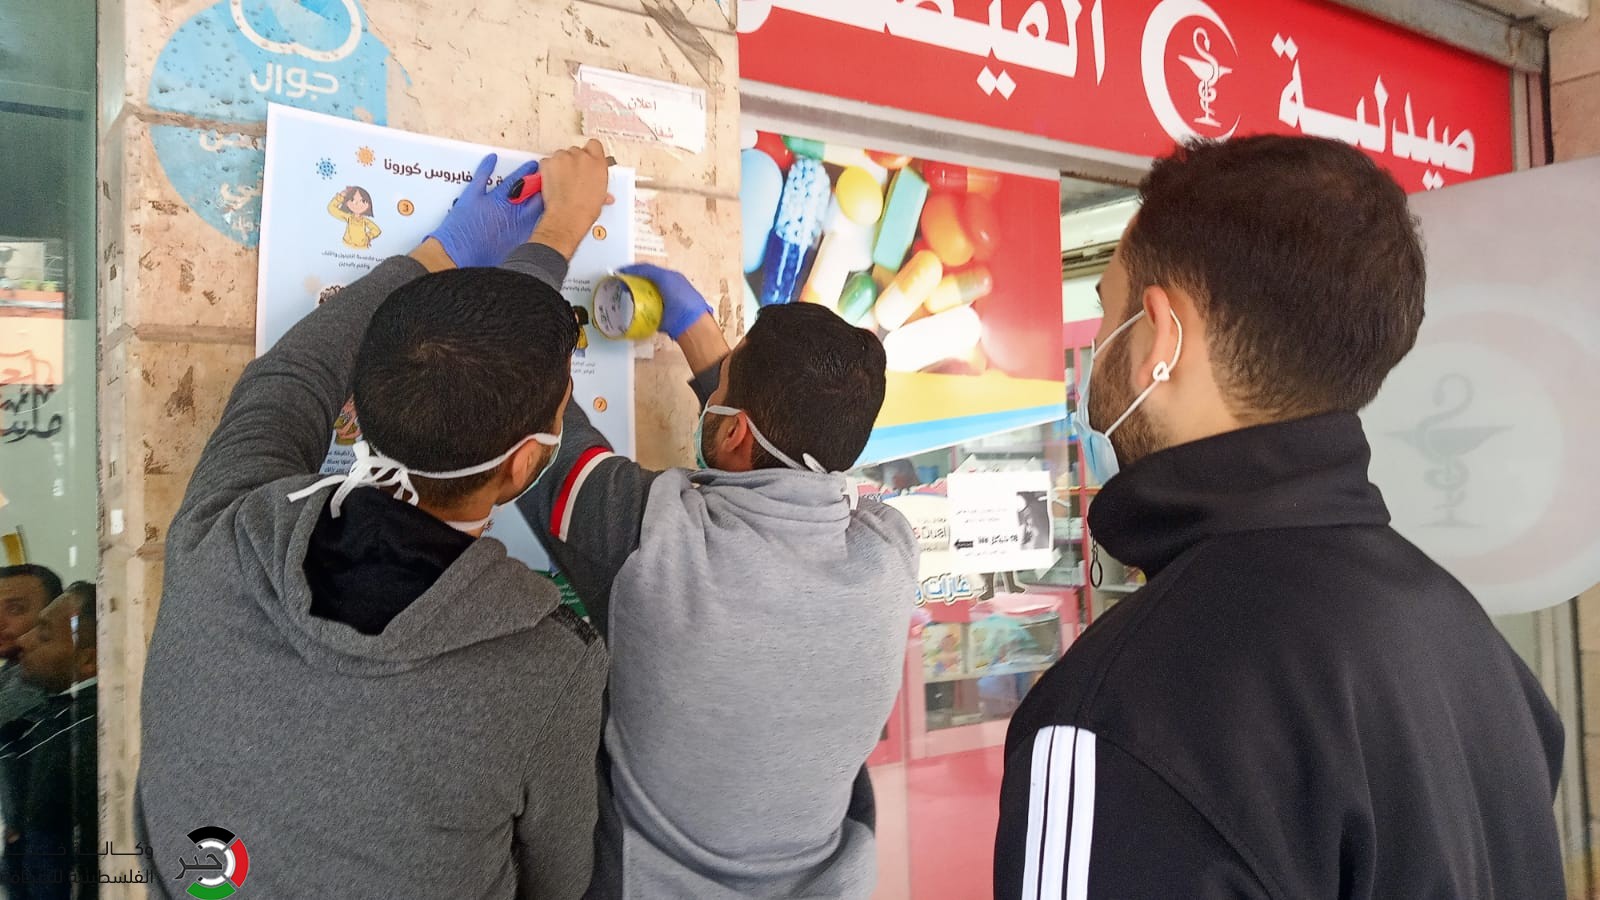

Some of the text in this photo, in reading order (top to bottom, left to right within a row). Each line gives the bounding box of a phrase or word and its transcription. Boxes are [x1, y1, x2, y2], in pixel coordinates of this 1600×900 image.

[250, 63, 340, 100] جوال
[1271, 32, 1475, 190] صيدلية
[384, 158, 421, 176] كورونا
